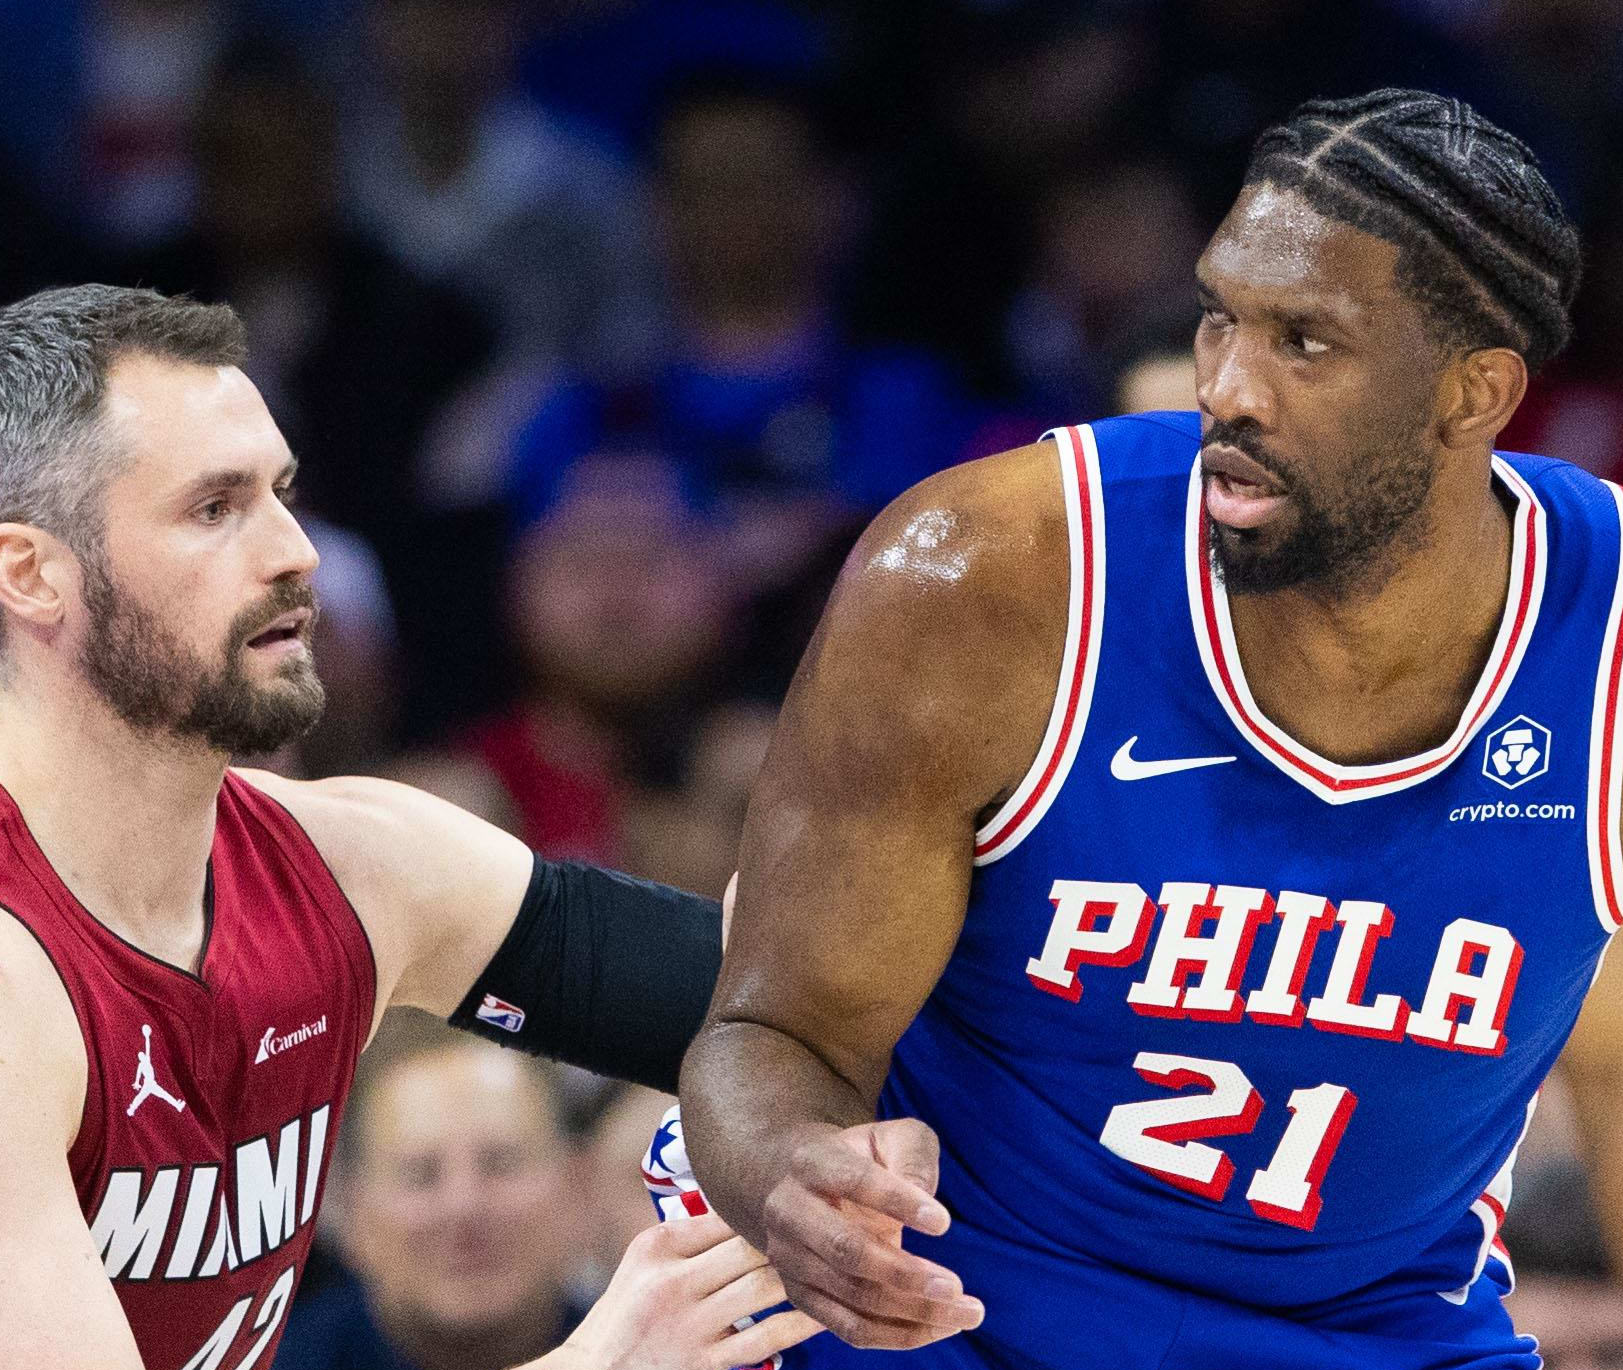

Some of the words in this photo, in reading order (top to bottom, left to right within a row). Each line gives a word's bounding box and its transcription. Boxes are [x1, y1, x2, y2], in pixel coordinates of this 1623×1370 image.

[1448, 800, 1576, 822] crypto.com
[269, 1013, 327, 1056] Carnival
[1026, 879, 1525, 1057] PHILA
[89, 1103, 330, 1281] MIAMI
[1100, 1051, 1359, 1232] 21
